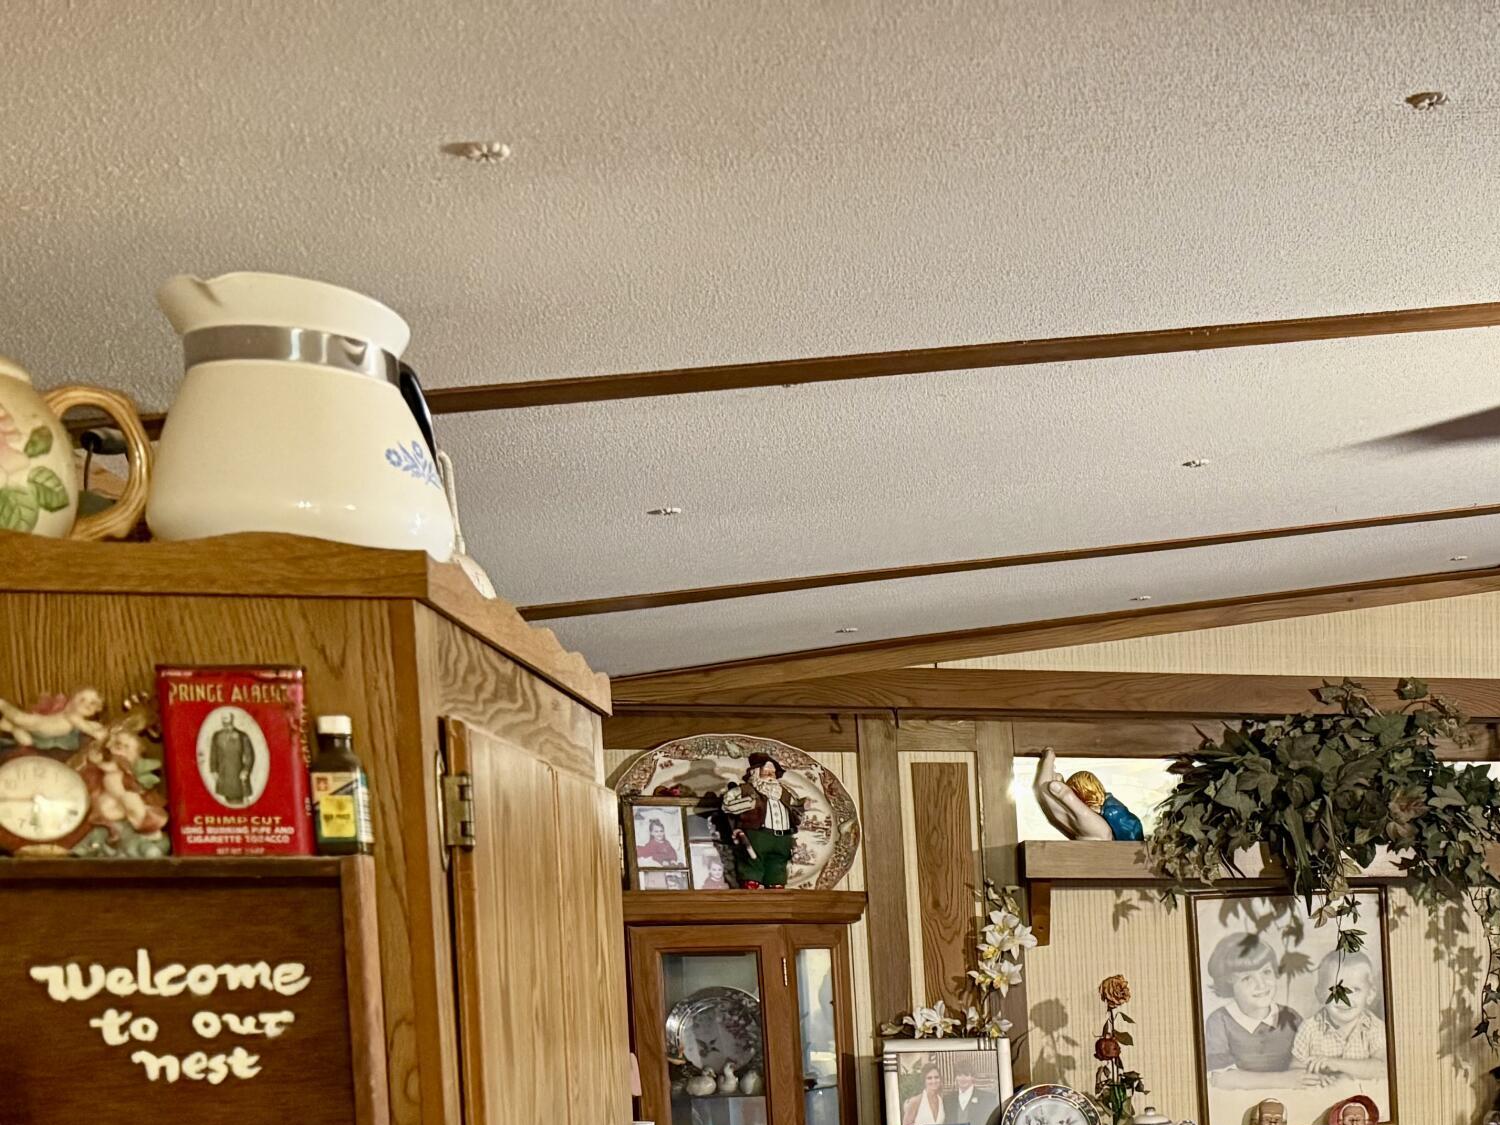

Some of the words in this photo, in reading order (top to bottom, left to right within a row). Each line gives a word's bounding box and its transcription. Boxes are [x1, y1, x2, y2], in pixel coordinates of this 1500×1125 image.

[168, 682, 225, 705] PRINCE
[193, 815, 248, 825] CRIMP
[250, 815, 282, 825] CUT
[274, 826, 295, 835] AND
[89, 1008, 158, 1046] to
[192, 1010, 295, 1039] our
[131, 1046, 263, 1085] nest
